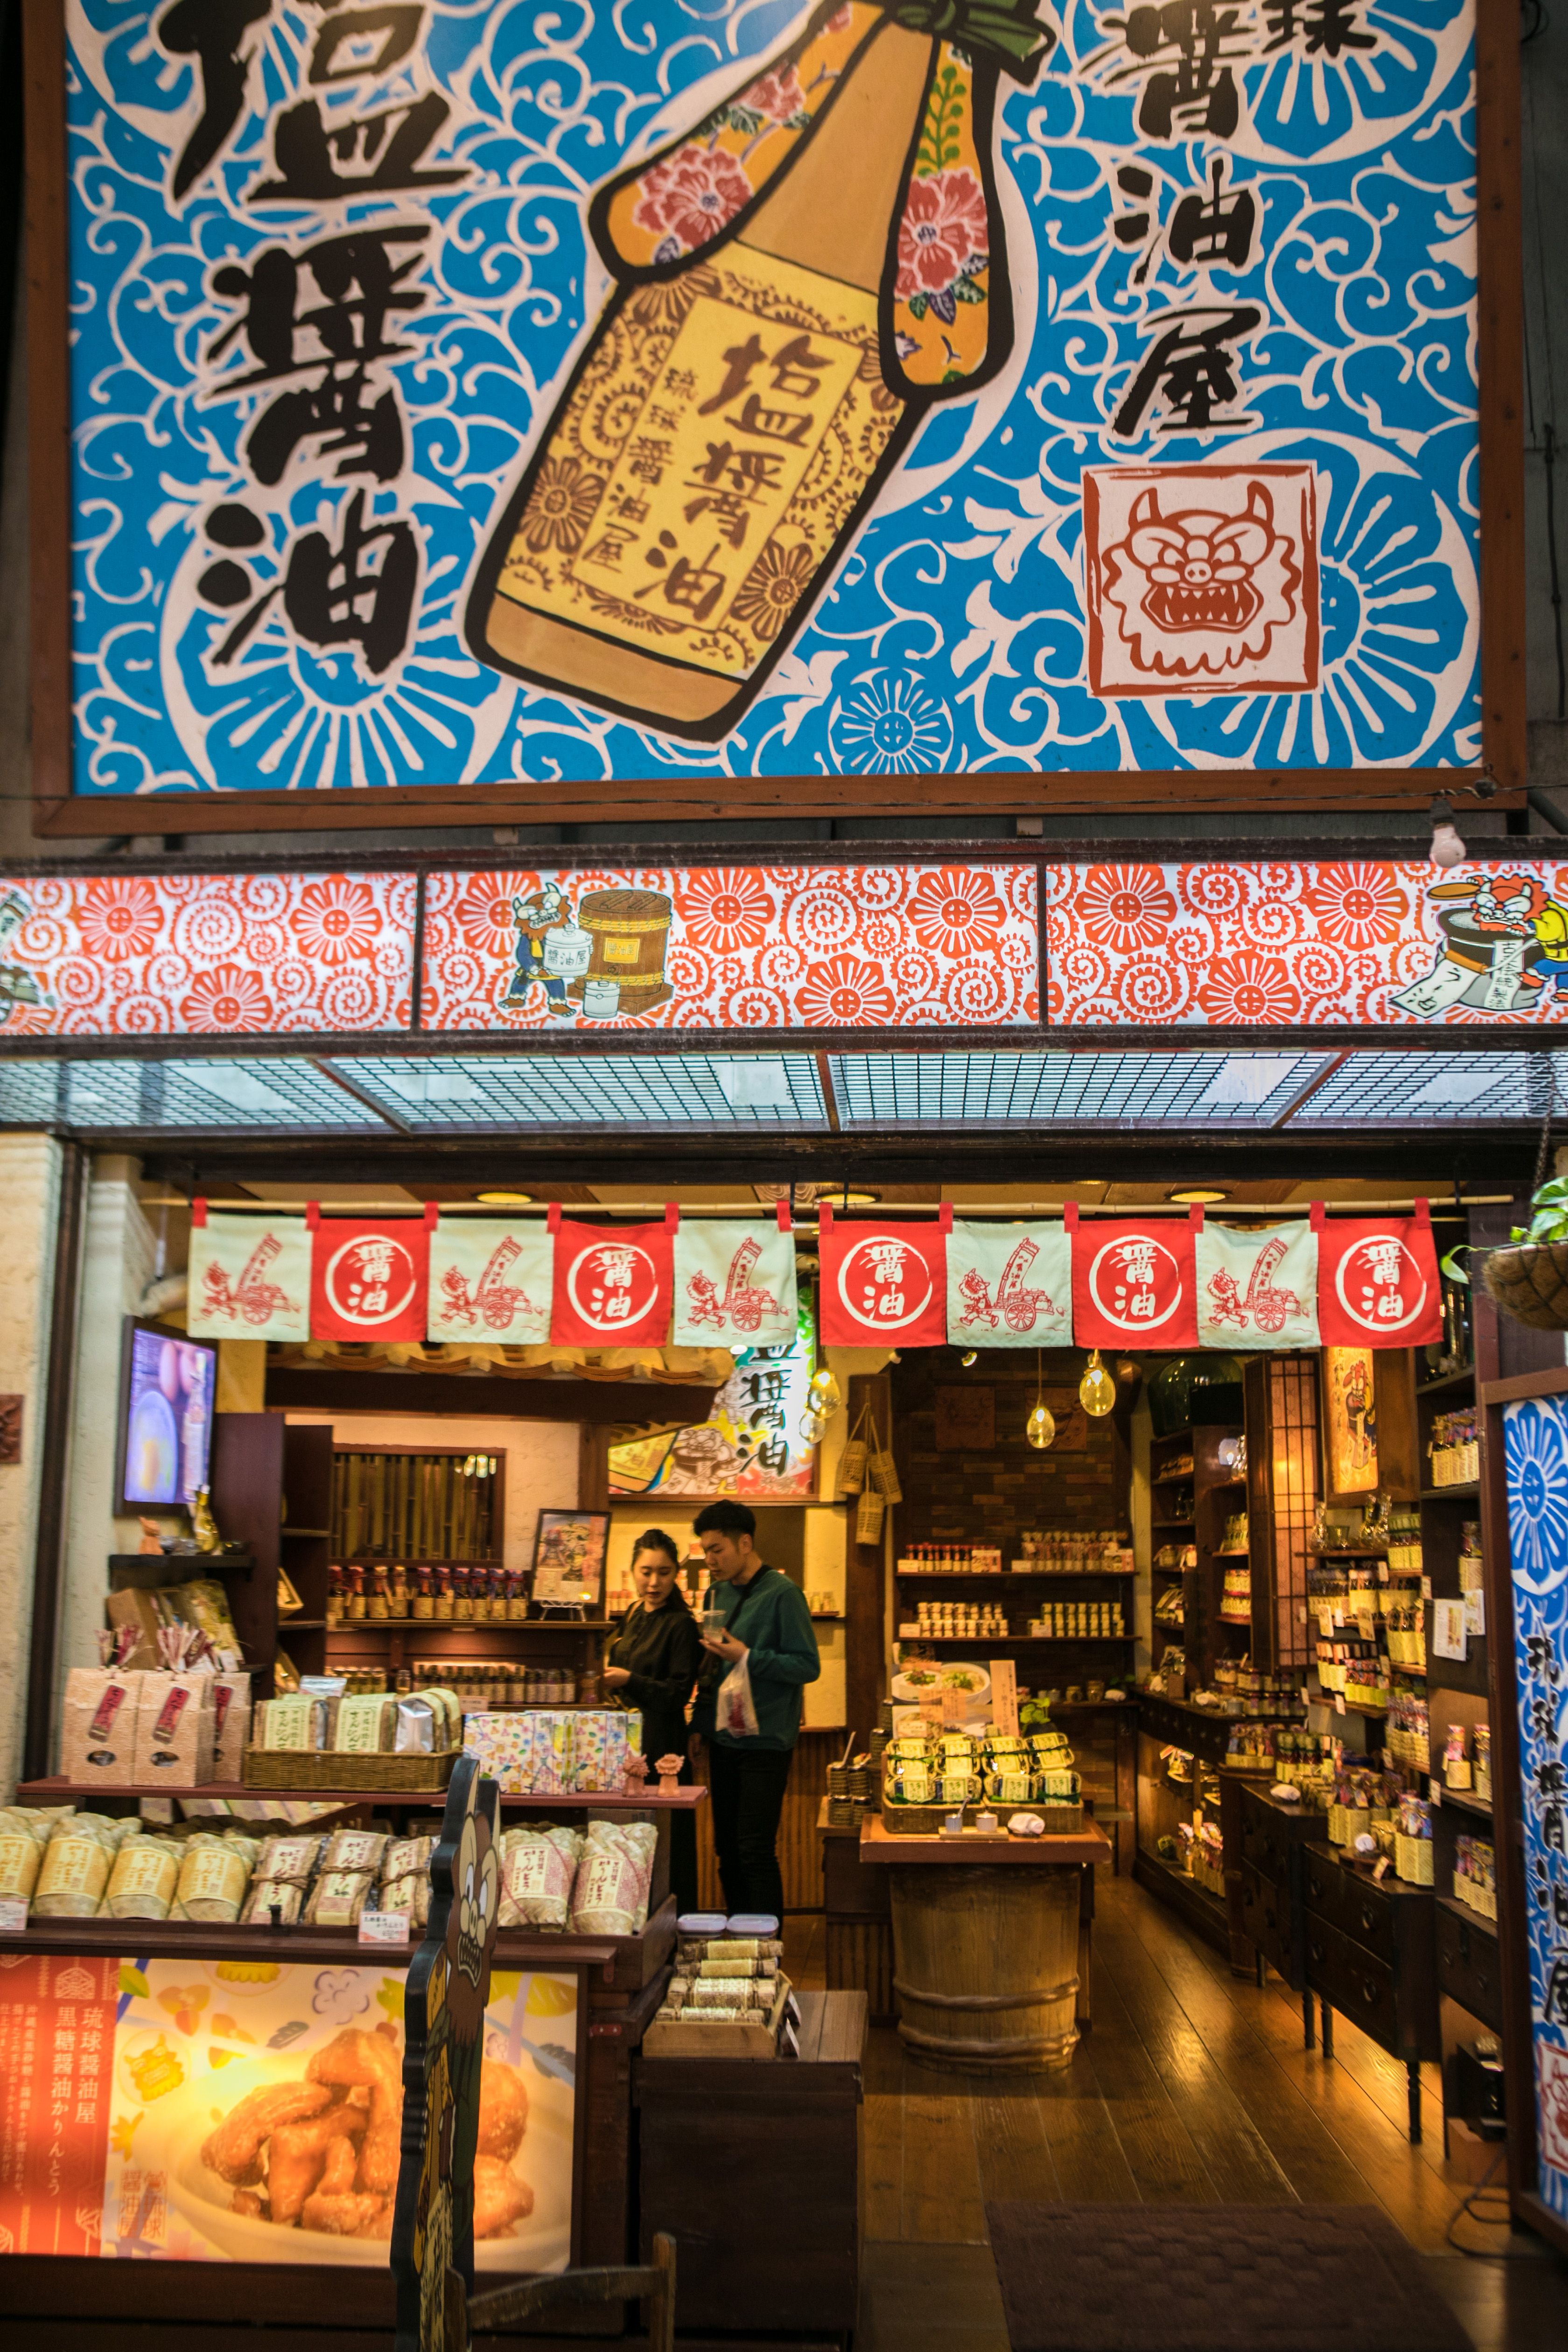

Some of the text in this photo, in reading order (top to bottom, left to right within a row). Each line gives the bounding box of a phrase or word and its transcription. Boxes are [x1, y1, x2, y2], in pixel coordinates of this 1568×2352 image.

[633, 333, 834, 622] 塩醤油
[347, 1243, 396, 1316] 醤油
[590, 1249, 637, 1323] 醤油
[859, 1244, 907, 1320] 醤油
[1109, 1243, 1157, 1322] 醤油
[1356, 1242, 1404, 1323] 醤油
[48, 2006, 79, 2197] 黒糖醤油かりんとう
[75, 2006, 104, 2124] 琉球醤油屋
